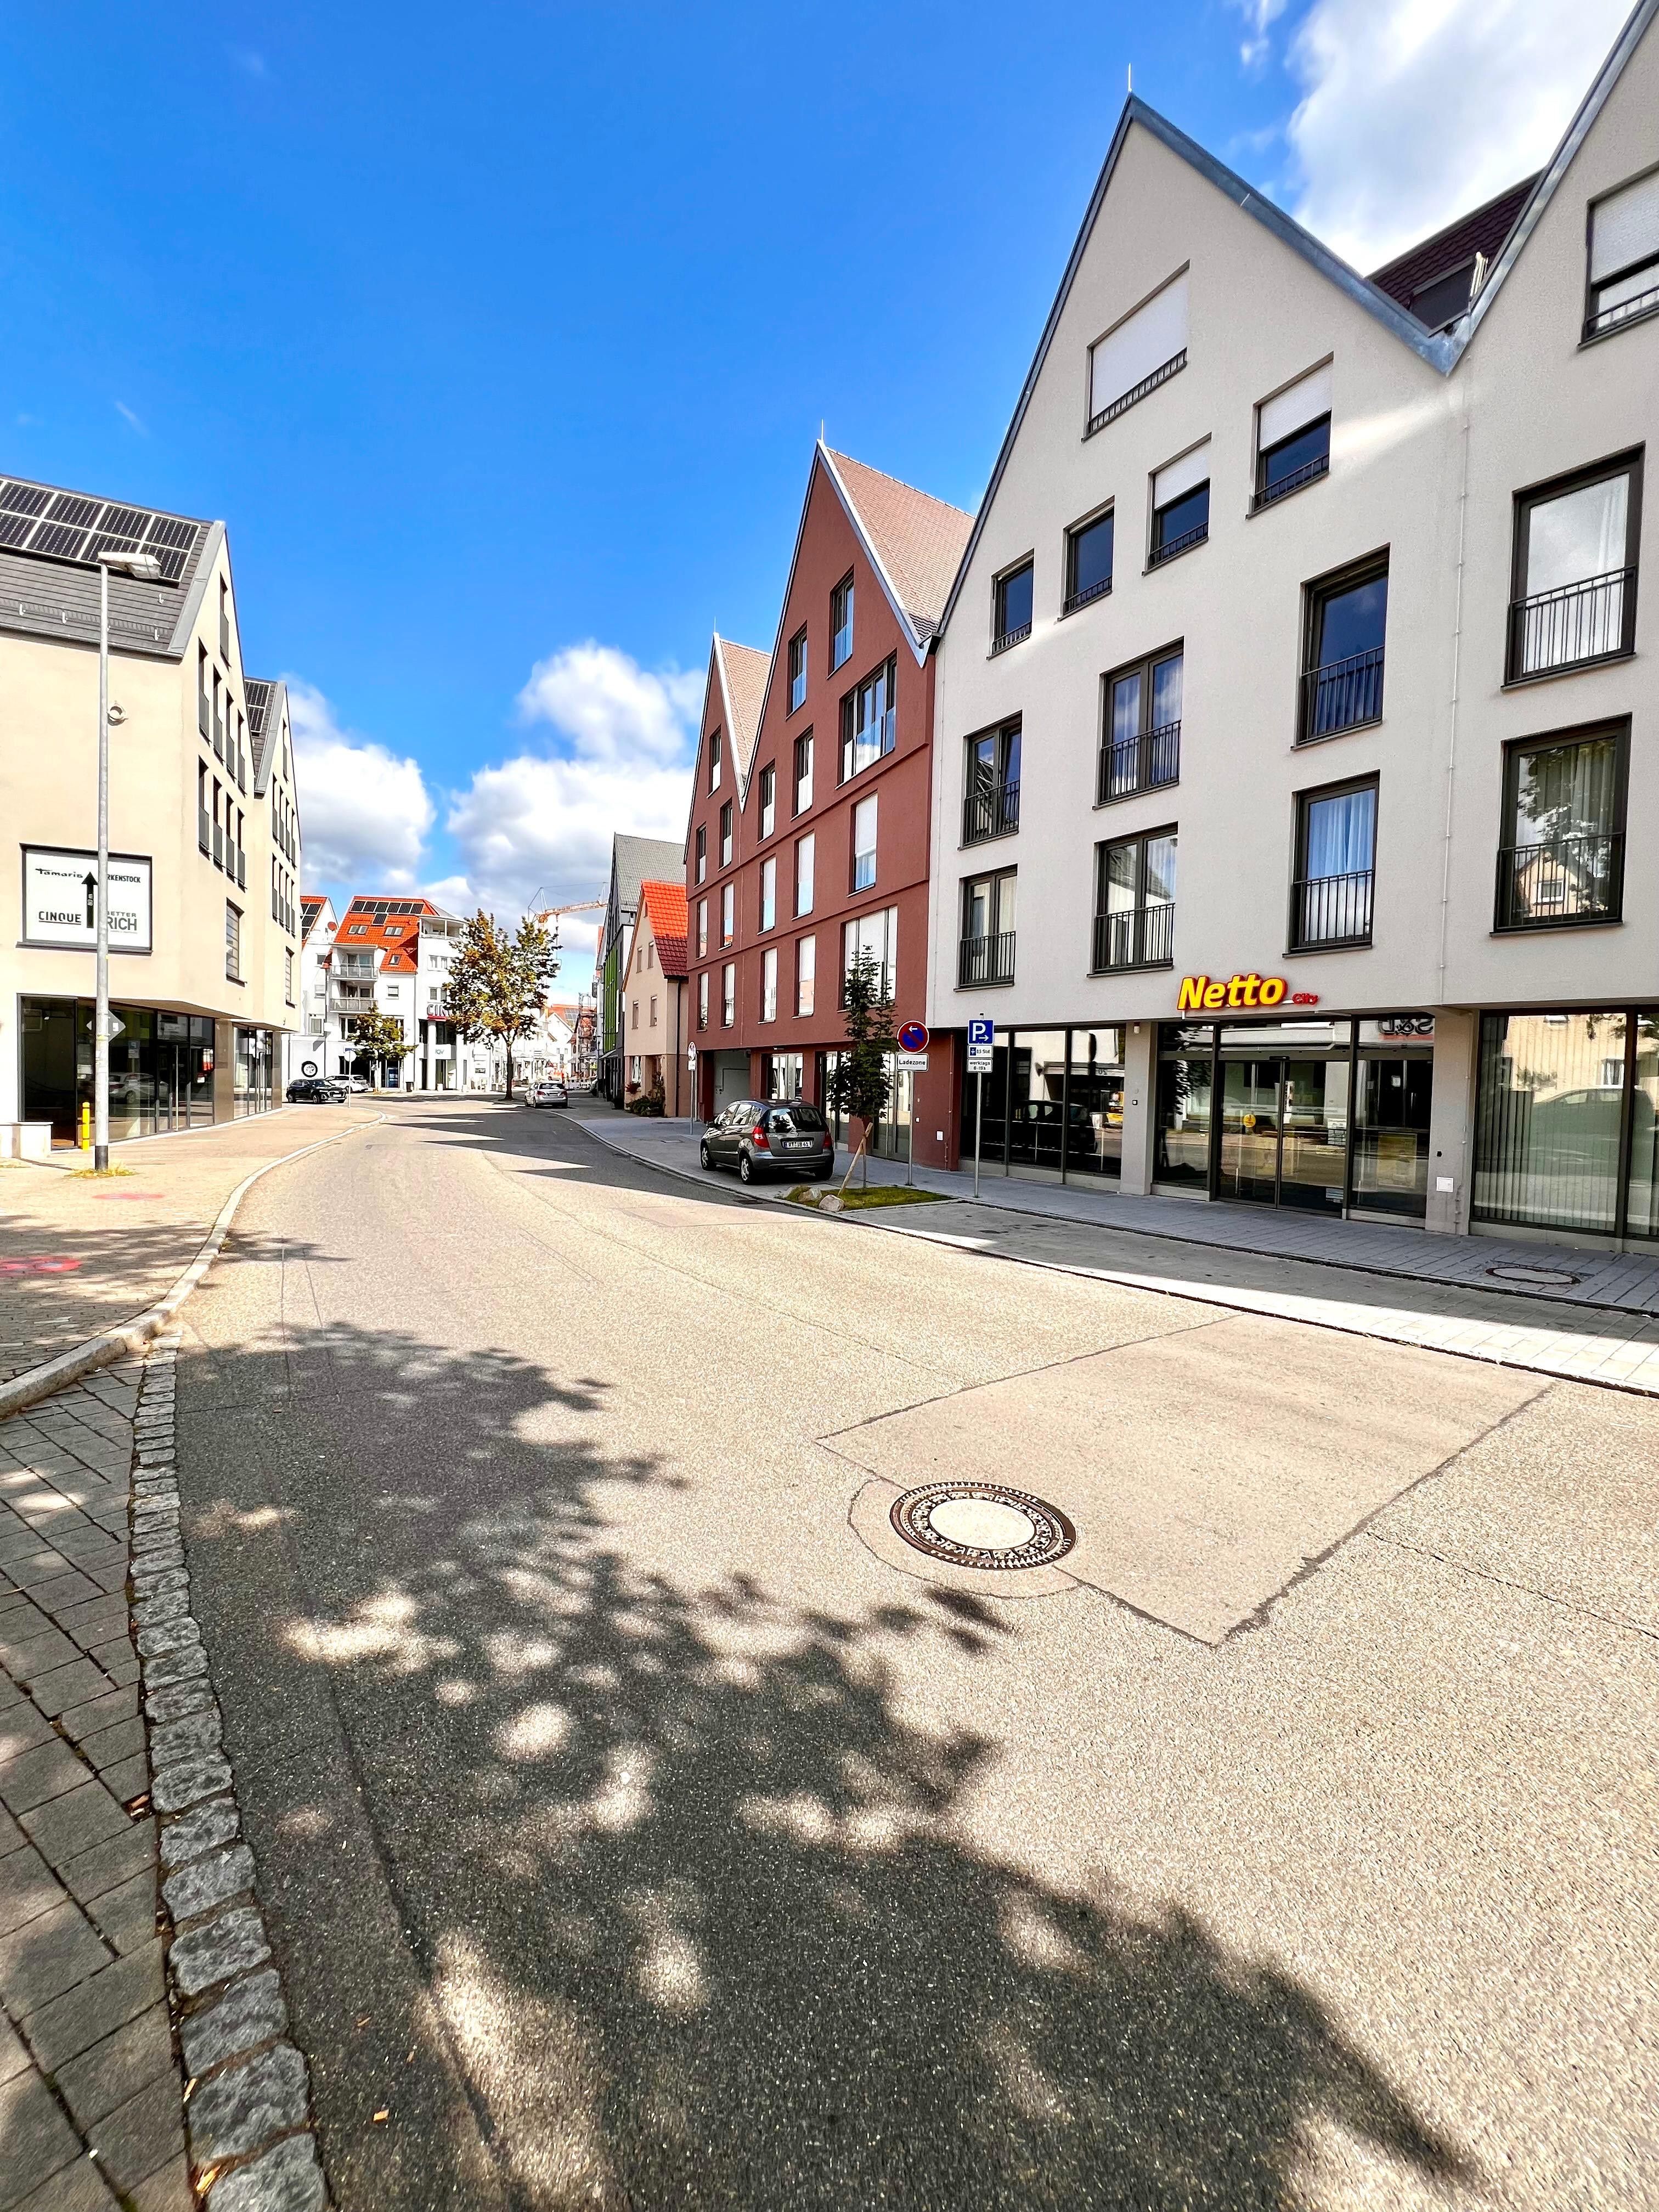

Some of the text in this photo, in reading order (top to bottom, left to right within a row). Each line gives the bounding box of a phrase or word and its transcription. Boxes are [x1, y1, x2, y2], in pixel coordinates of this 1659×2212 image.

[35, 868, 83, 878] Tamaris
[107, 874, 140, 883] RKENSTOCK
[38, 911, 81, 923] CINQUE
[107, 916, 137, 931] RICH
[1177, 973, 1288, 1010] Netto
[1293, 993, 1318, 1005] City
[972, 1023, 986, 1041] P
